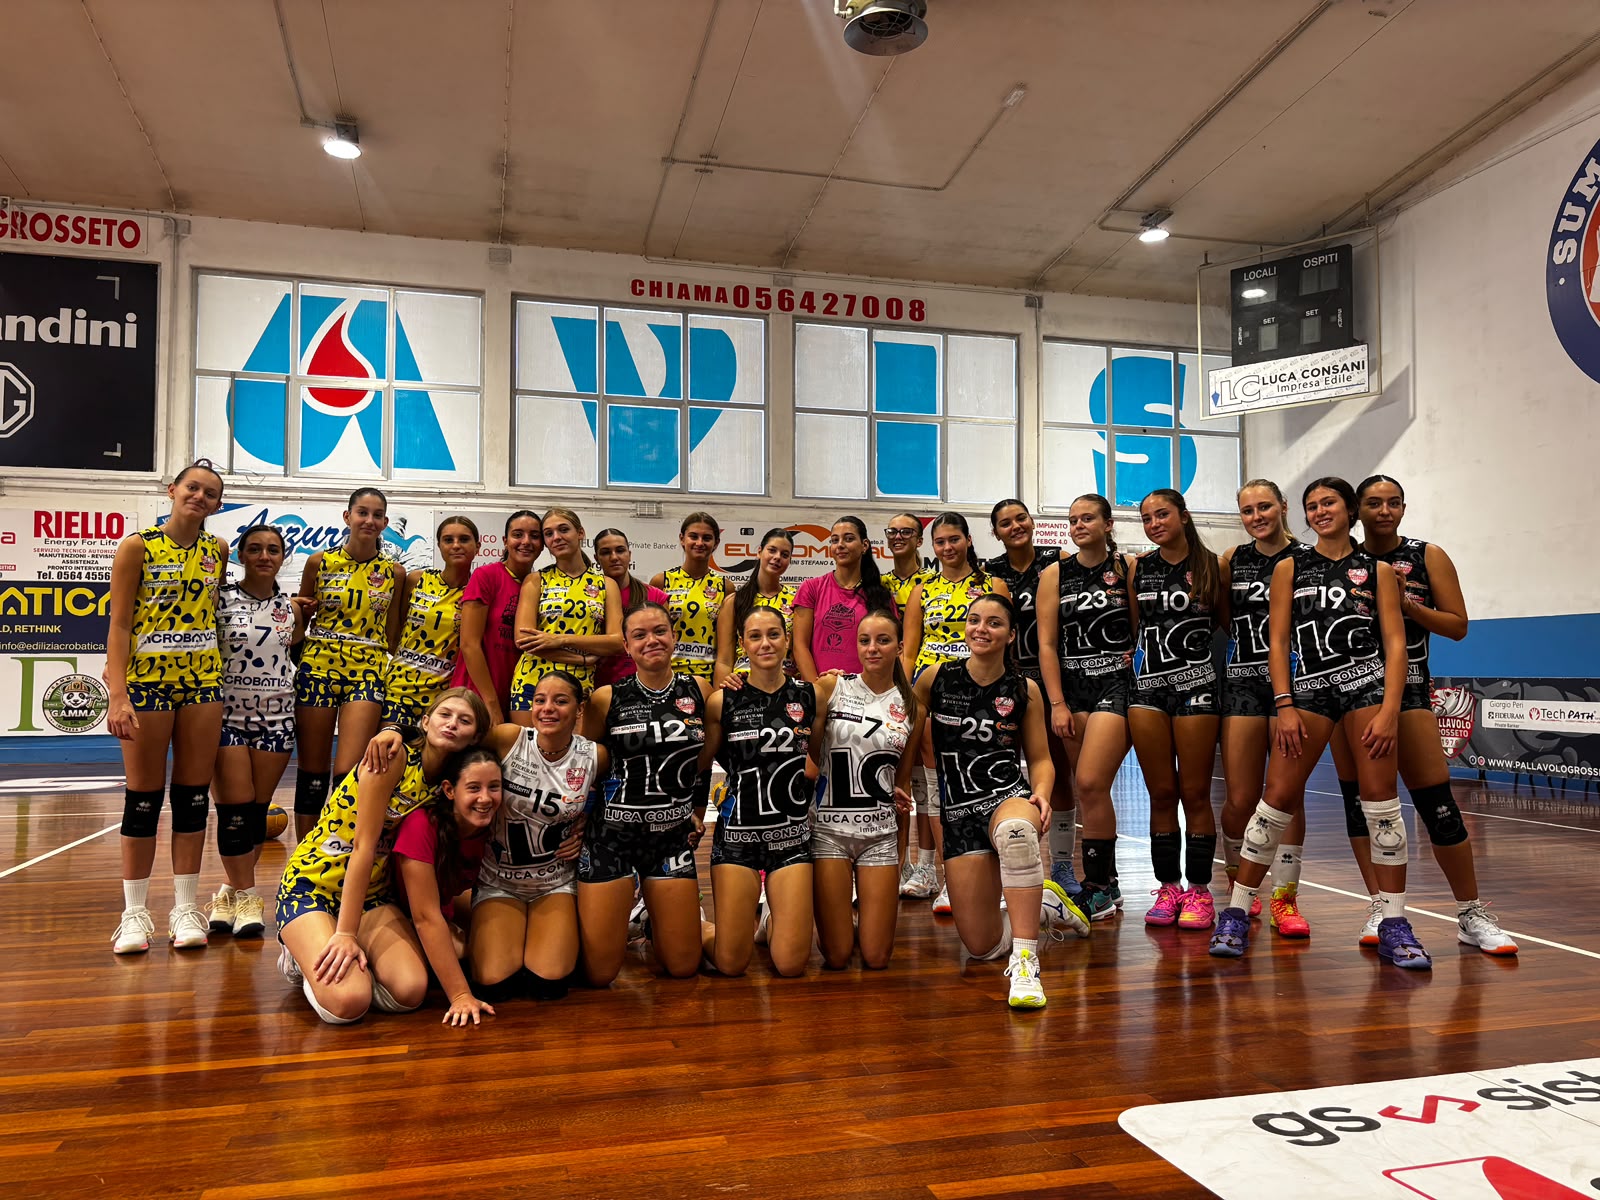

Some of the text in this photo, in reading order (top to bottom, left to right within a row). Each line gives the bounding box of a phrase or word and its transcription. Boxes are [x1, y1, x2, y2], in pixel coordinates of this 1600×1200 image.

[1303, 253, 1338, 268] OSPITI
[1244, 266, 1277, 281] LOCALI
[1263, 316, 1276, 325] SET
[1305, 308, 1319, 317] SET
[0, 307, 138, 349] ndini
[1262, 360, 1365, 386] LUCA CONSANI
[1277, 374, 1353, 393] Impresa Edile
[33, 510, 125, 540] RIELLO
[44, 538, 79, 547] Energy
[100, 539, 118, 547] Life
[628, 541, 678, 550] Private Banker
[37, 570, 111, 581] Tel. 0564 4556
[181, 578, 205, 601] 19
[1249, 581, 1270, 601] 2
[1318, 585, 1347, 609] 19
[347, 588, 363, 610] 11
[1077, 590, 1108, 611] 23
[1160, 590, 1190, 612] 10
[563, 598, 587, 620] 23
[686, 601, 700, 619] 9
[944, 604, 968, 622] 22
[14, 624, 62, 633] RETHINK
[433, 610, 444, 631] 1
[254, 625, 272, 647] 7
[1226, 666, 1256, 678] LUCA
[1137, 677, 1168, 691] LUCA
[1174, 678, 1207, 692] Impresa
[1294, 678, 1331, 693] LUCA
[1338, 673, 1375, 693] Impresa
[51, 709, 97, 718] GAMMA
[1489, 700, 1524, 709] Giorgio Peri
[1494, 712, 1525, 720] FIDEURAM
[1540, 708, 1595, 720] Tech PATH
[649, 719, 689, 744] 12
[863, 716, 883, 739] 7
[961, 716, 994, 742] 25
[1438, 718, 1472, 730] LLAVOLO
[759, 726, 795, 753] 22
[531, 788, 562, 817] 15
[603, 807, 643, 823] LUCA
[816, 809, 896, 824] LUCA CONSA
[724, 830, 761, 843] LUCA
[768, 838, 802, 851] Impresa
[1252, 1106, 1381, 1147] gs
